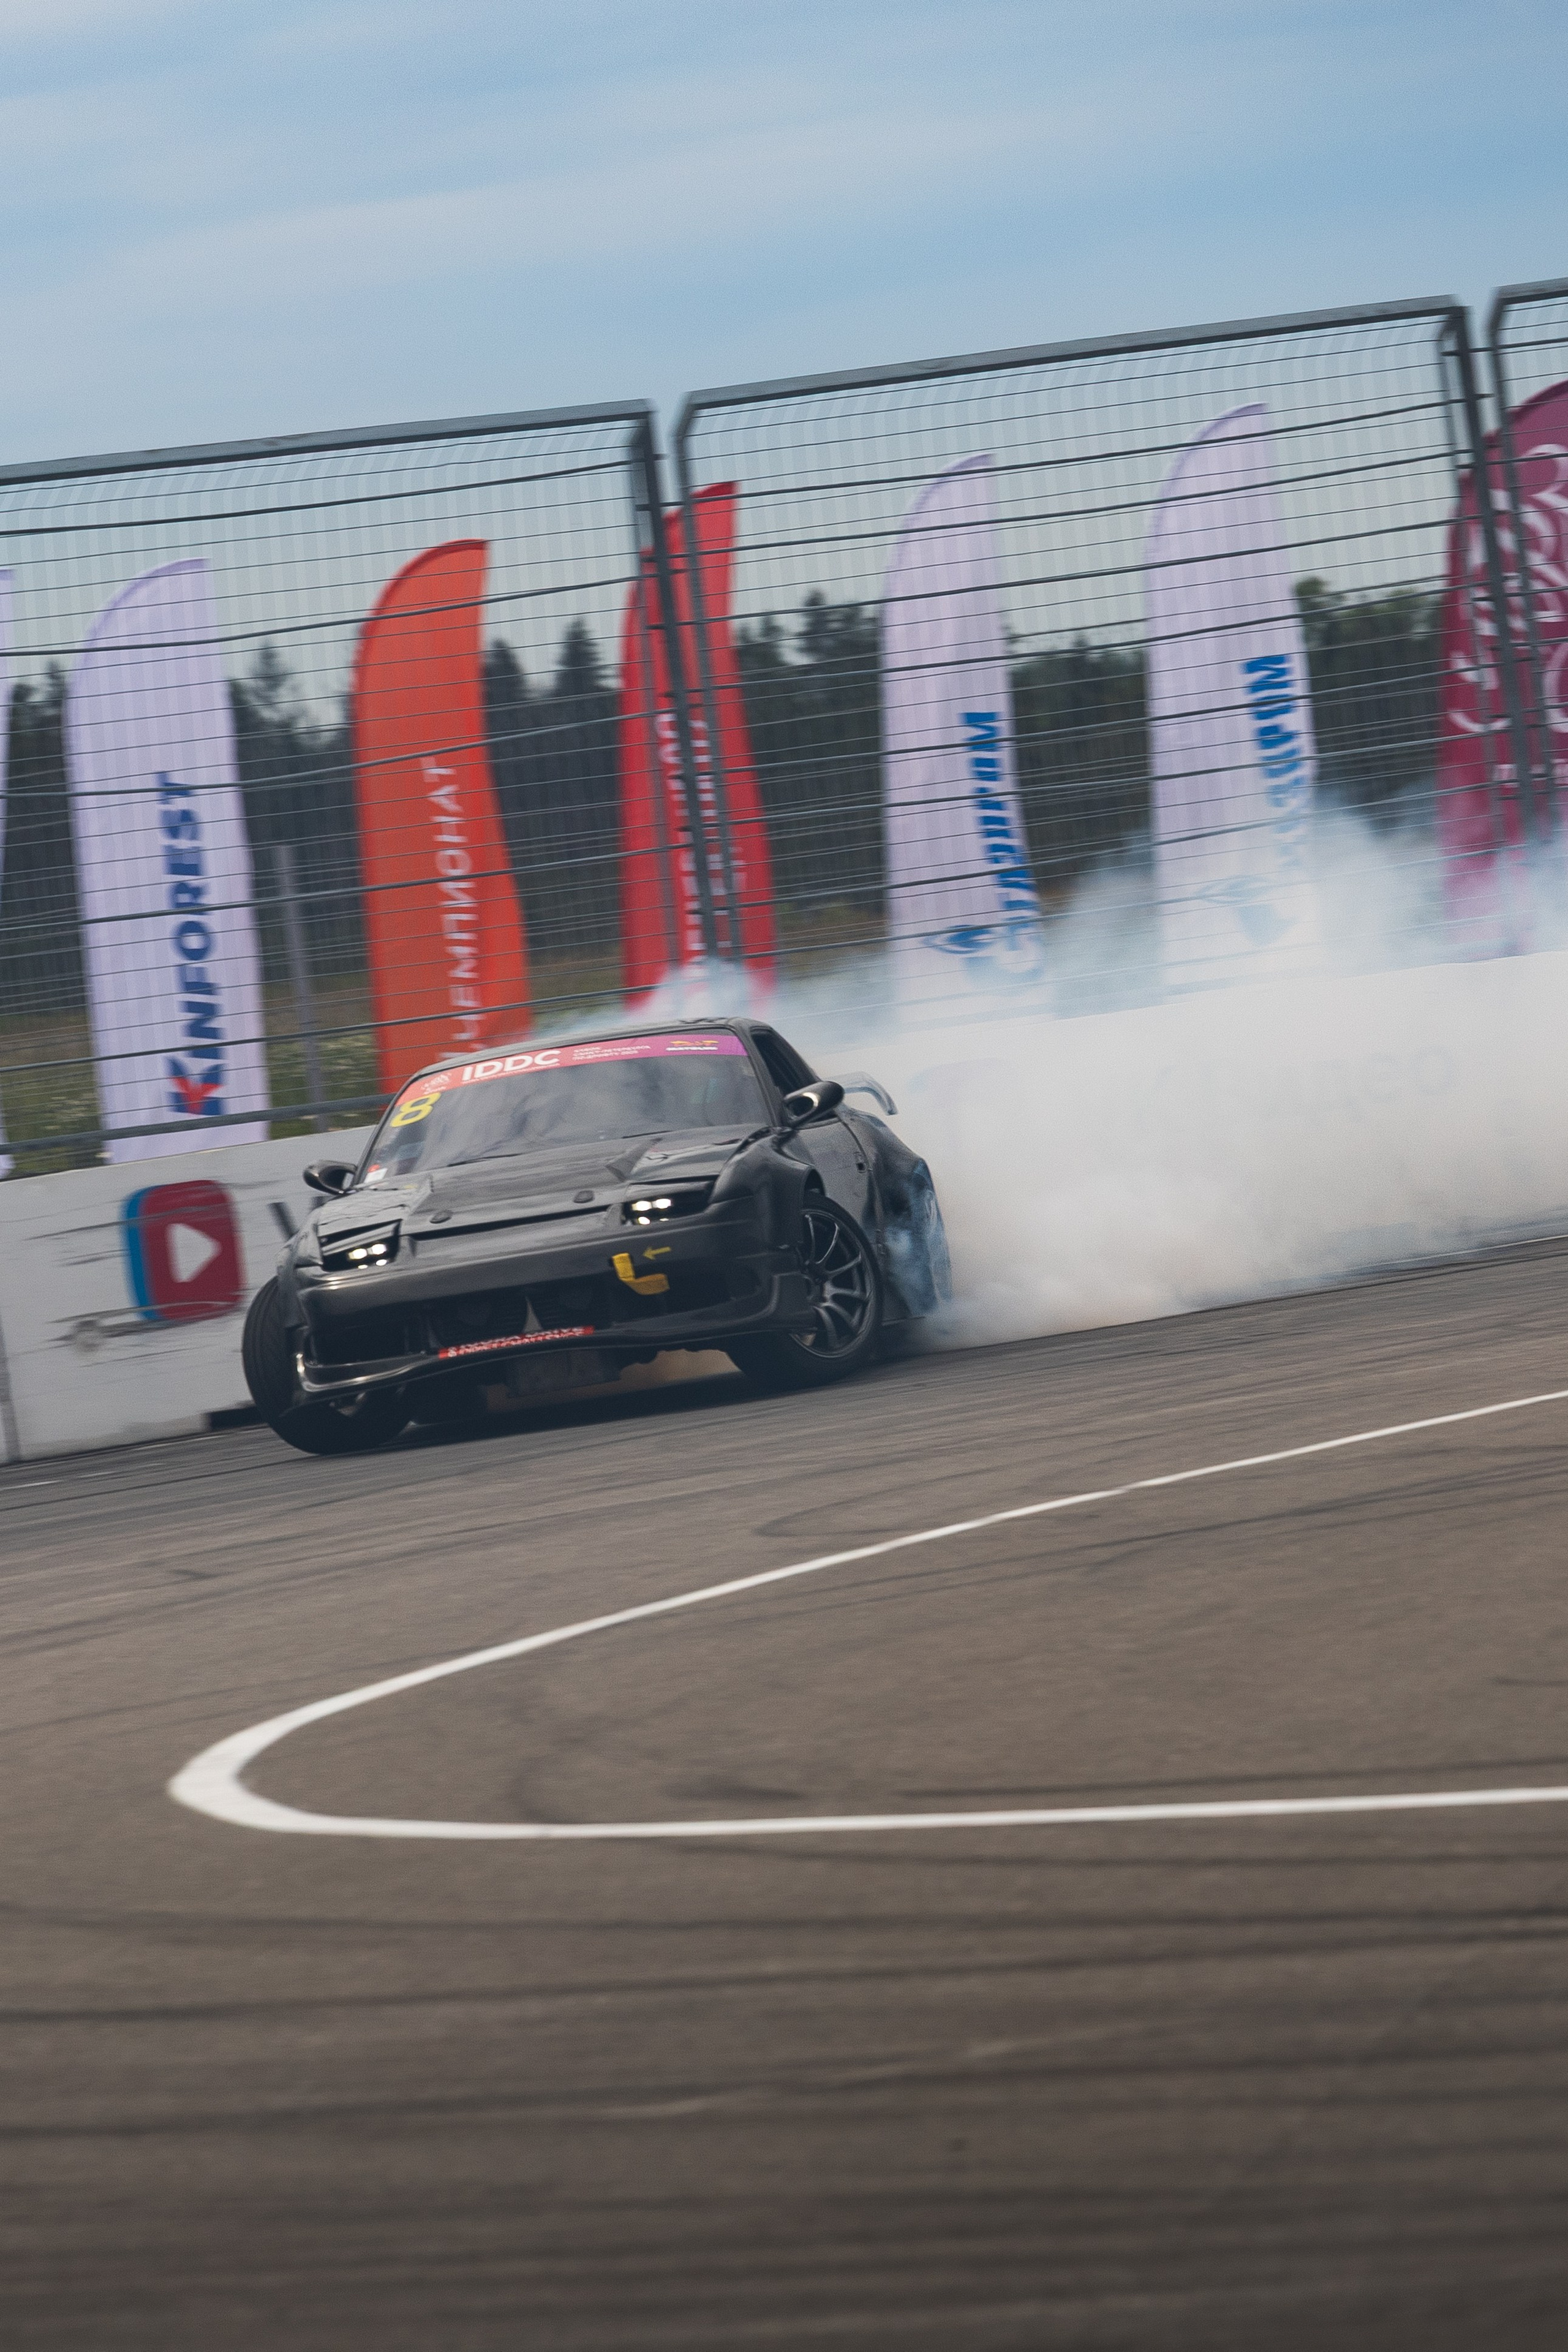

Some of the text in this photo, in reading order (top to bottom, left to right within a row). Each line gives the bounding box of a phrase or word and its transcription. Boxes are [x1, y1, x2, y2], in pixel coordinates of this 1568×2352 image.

[157, 771, 227, 1115] KINFOREST
[421, 756, 485, 1040] ЧЕМПИОНАТ
[389, 1092, 442, 1128] 8
[461, 1050, 562, 1082] IDDC
